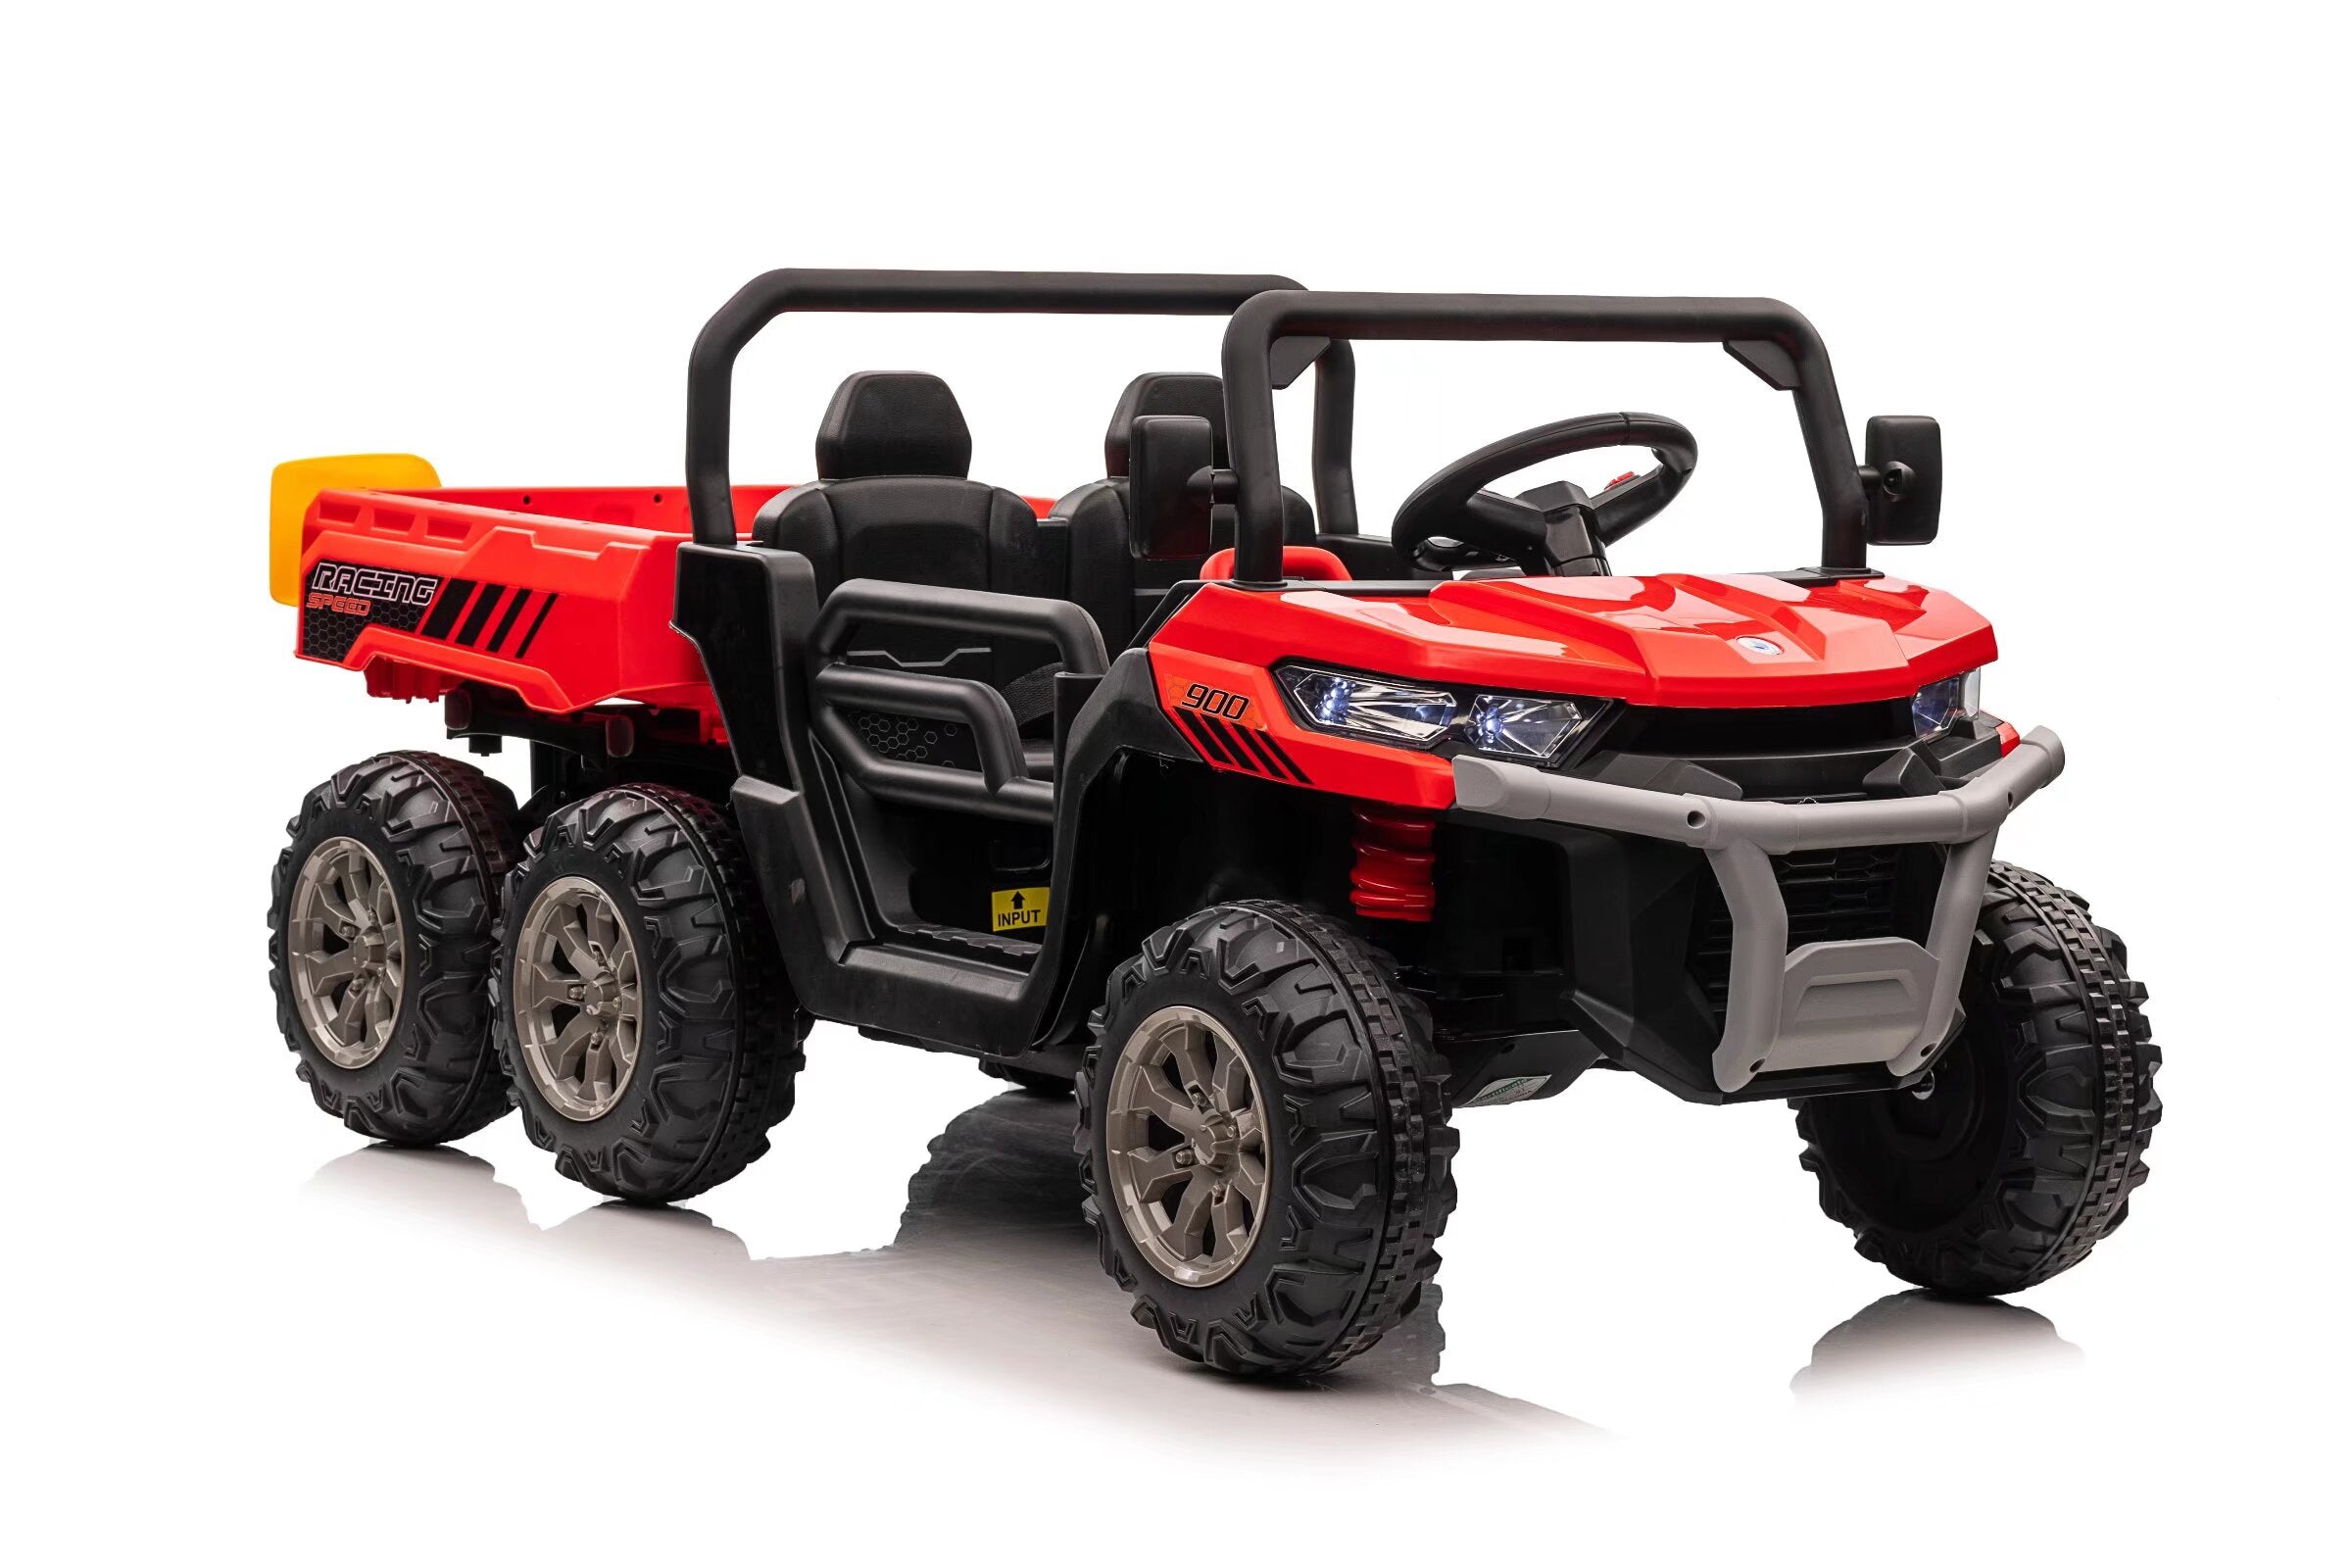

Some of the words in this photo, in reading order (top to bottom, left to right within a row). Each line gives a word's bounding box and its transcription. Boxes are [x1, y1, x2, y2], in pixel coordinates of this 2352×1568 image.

[313, 562, 438, 607] RACING
[306, 592, 370, 616] SPEED
[1181, 683, 1250, 720] 900
[998, 909, 1041, 927] INPUT
